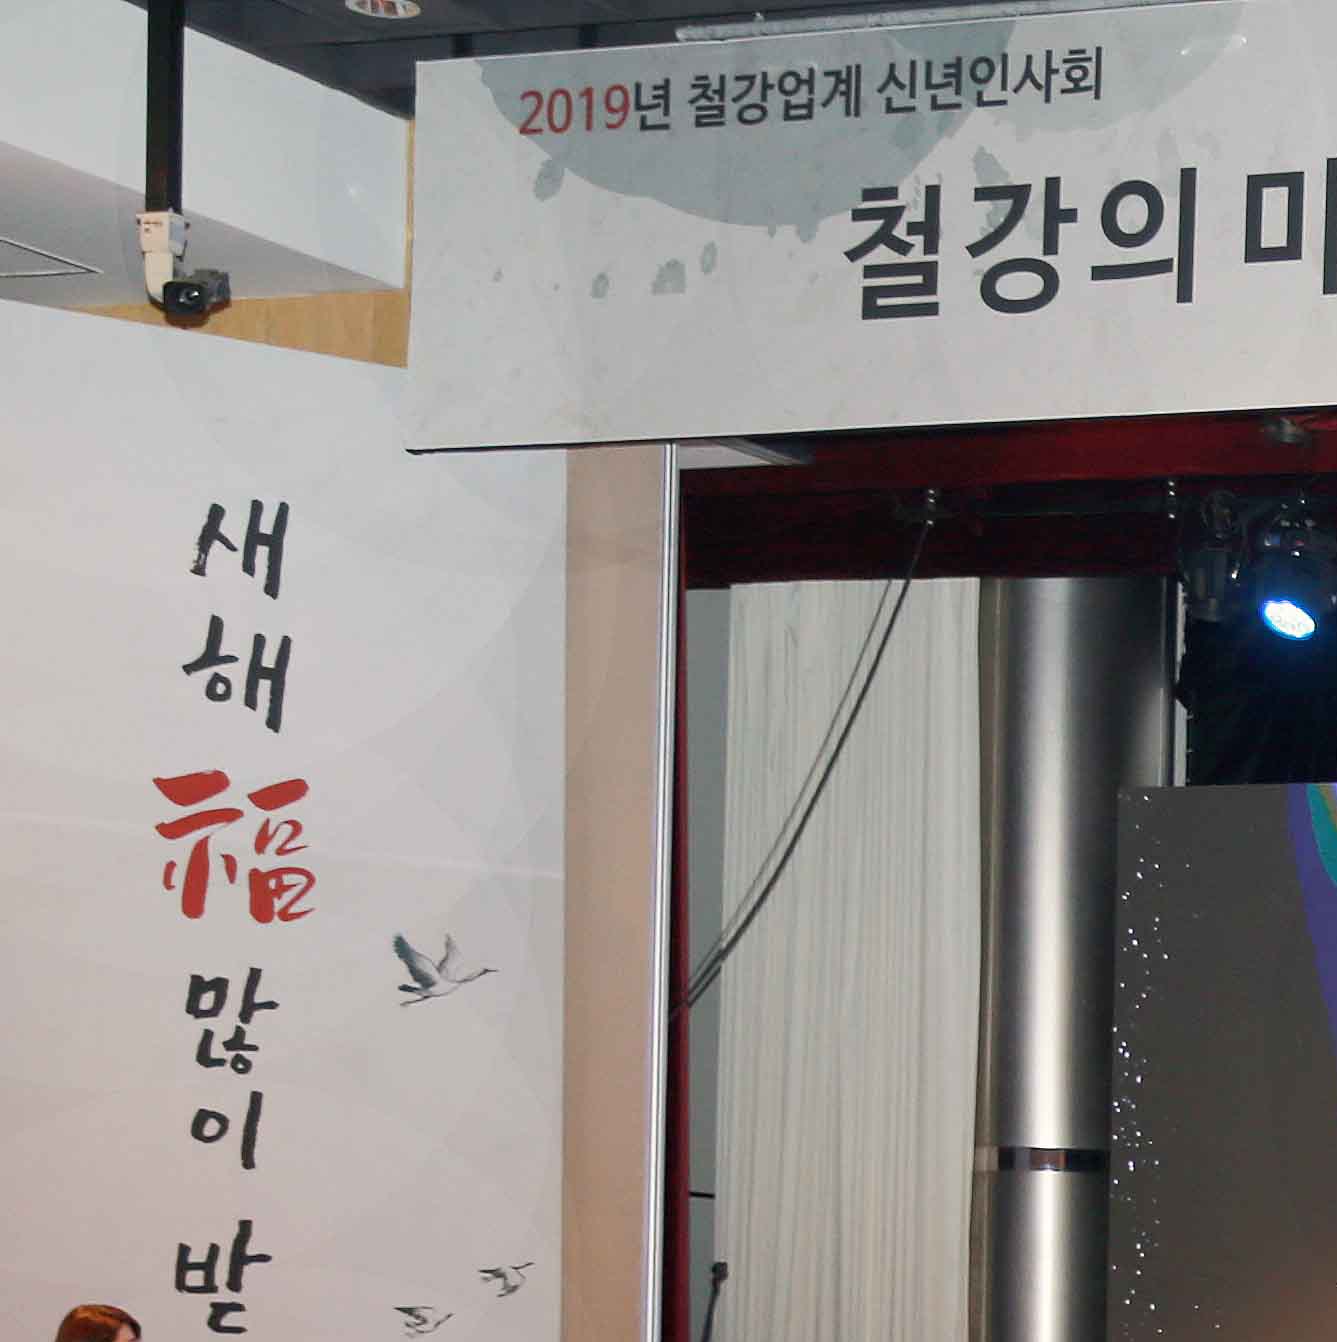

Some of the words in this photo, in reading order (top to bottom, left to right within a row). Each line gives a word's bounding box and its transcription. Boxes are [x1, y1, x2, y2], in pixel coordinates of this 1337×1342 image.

[519, 78, 671, 136] 2019년
[687, 64, 864, 129] 철강업계
[876, 46, 1104, 115] 신년인사회
[845, 167, 1197, 322] 철강의
[182, 499, 293, 734] 새해
[152, 768, 318, 925] 福
[184, 966, 279, 1171] 많이
